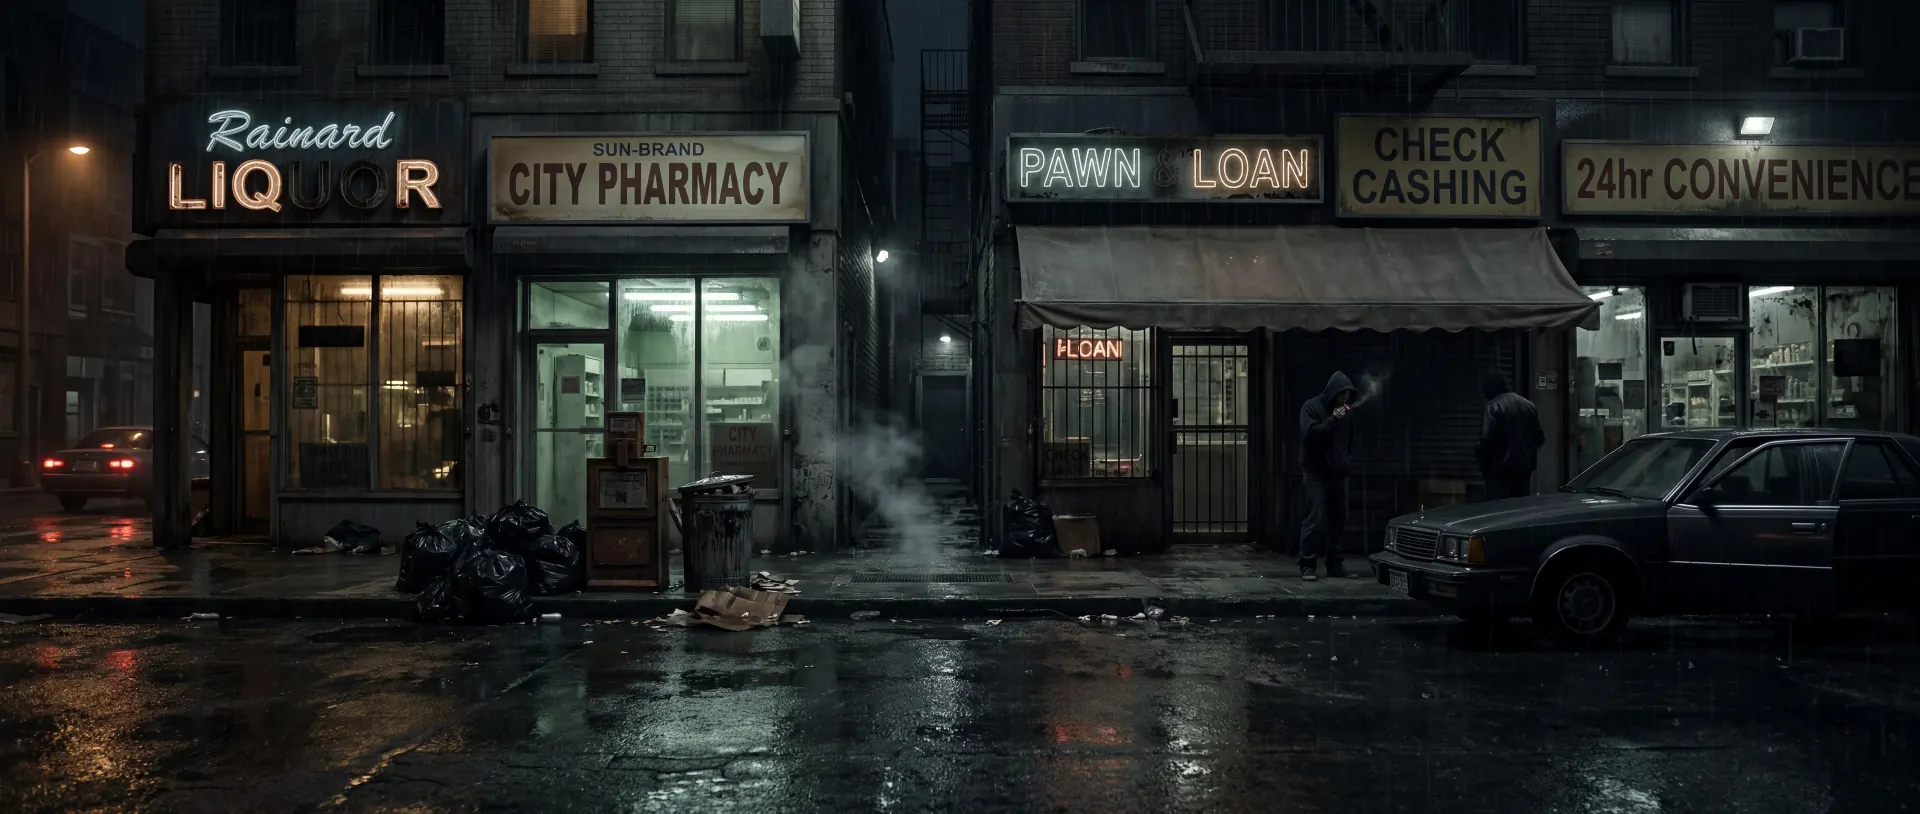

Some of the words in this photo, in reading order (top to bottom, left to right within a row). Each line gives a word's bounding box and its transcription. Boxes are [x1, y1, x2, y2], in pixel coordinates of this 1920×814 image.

[206, 110, 396, 152] Rainard
[593, 142, 705, 157] SUN-BRAND
[1374, 127, 1506, 162] CHECK
[169, 159, 440, 212] LIQUOR
[508, 162, 588, 206] CITY
[598, 162, 789, 206] PHARMACY
[1020, 148, 1141, 188] PAWN
[1193, 148, 1308, 188] LOAN
[1352, 168, 1527, 205] CASHING
[1577, 157, 1653, 199] 24hr
[1663, 158, 1920, 200] CONVENIENCE
[729, 427, 757, 441] CITY
